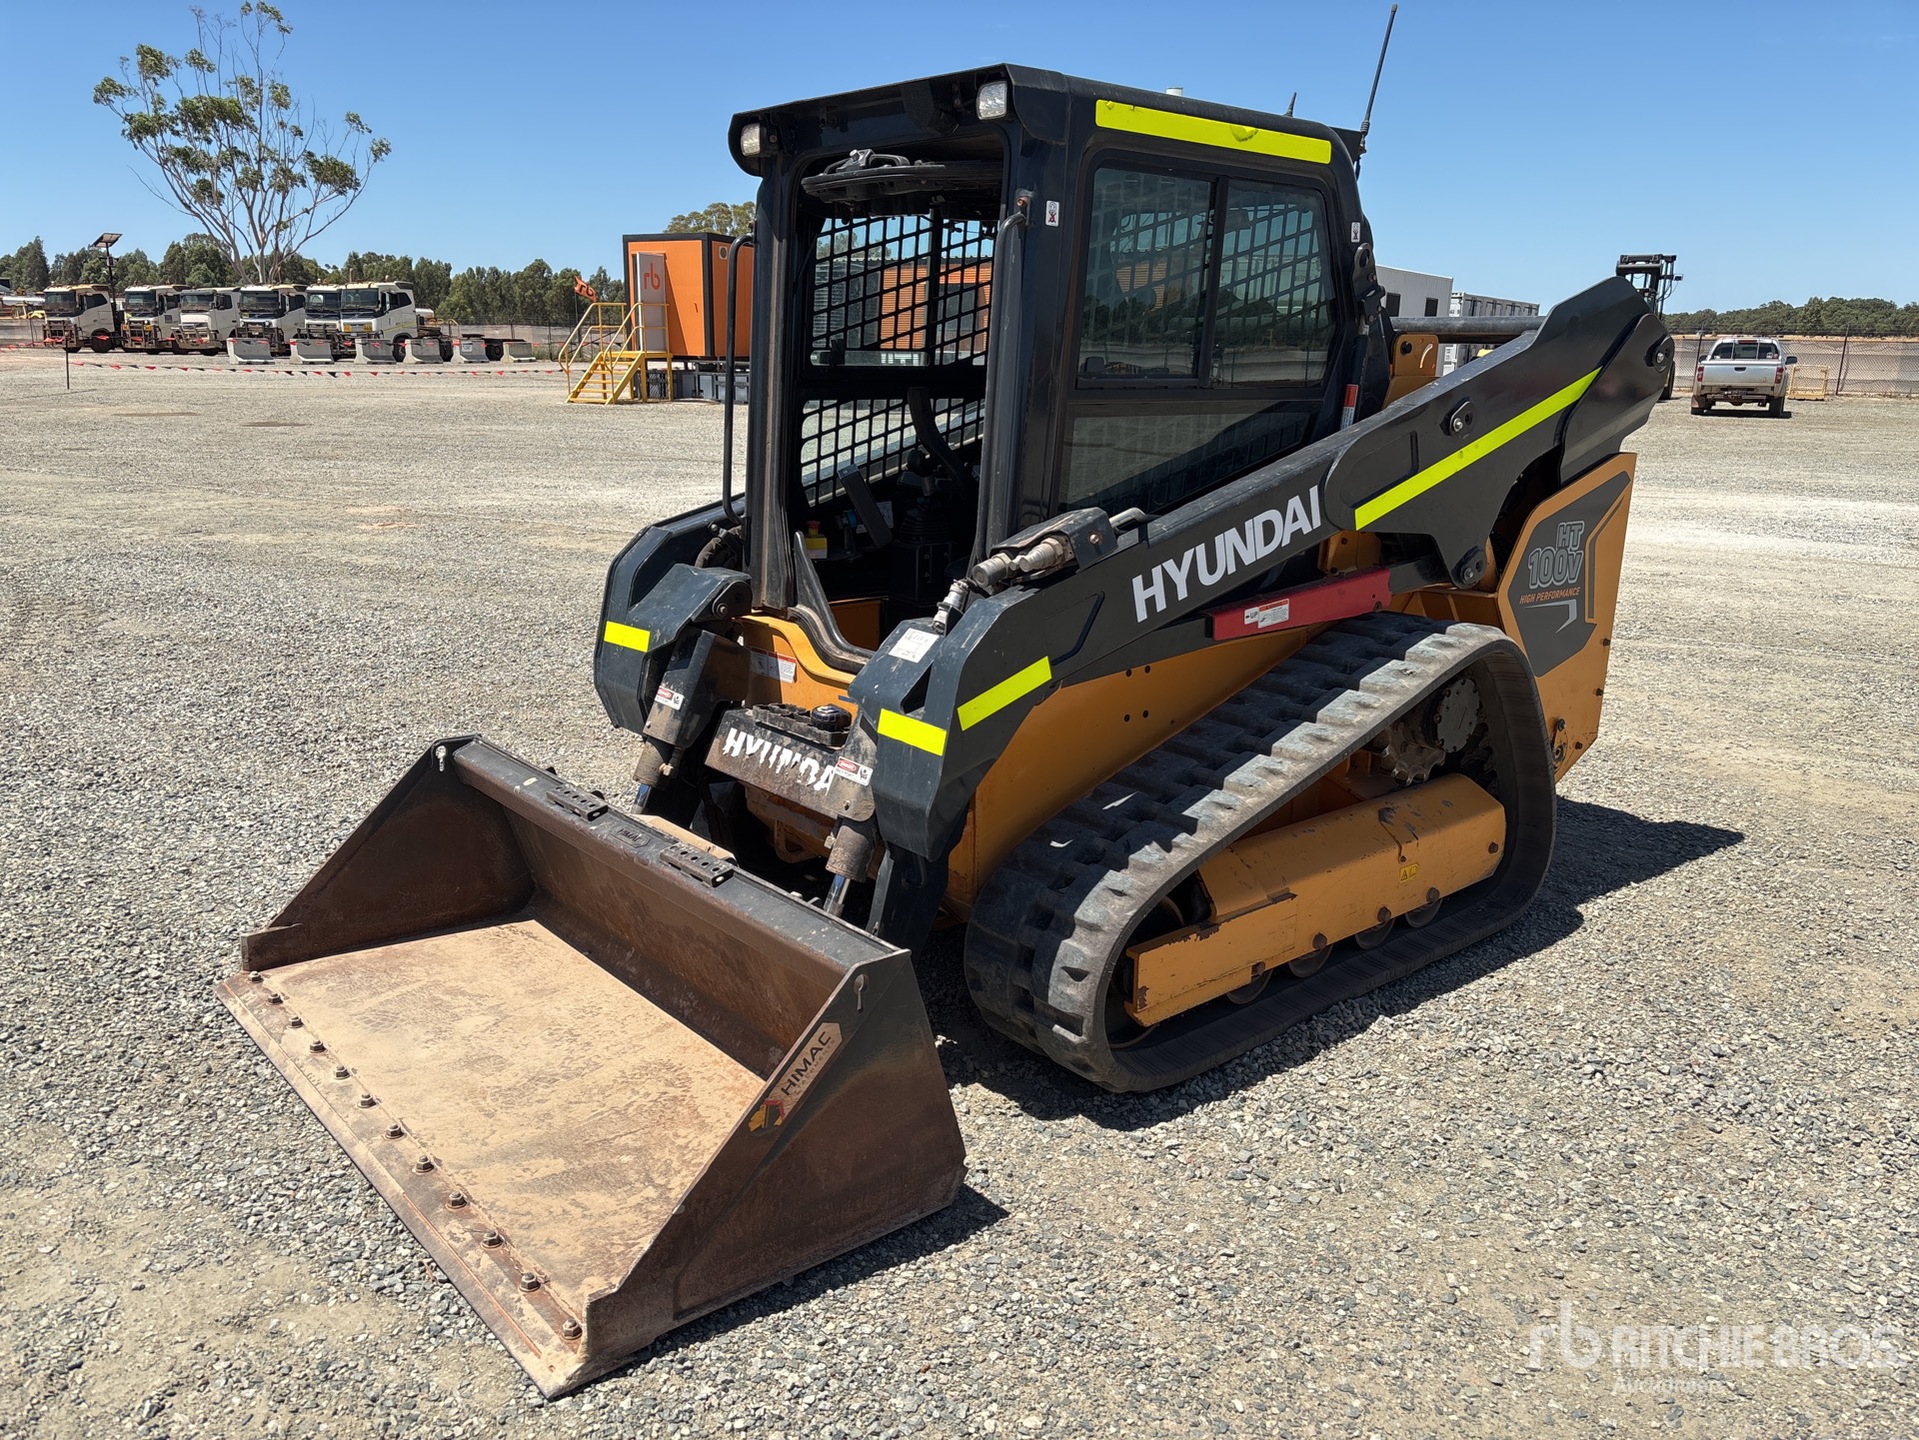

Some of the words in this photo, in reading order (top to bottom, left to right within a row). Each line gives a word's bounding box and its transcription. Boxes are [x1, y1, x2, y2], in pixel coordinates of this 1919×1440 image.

[643, 262, 661, 290] rb
[1557, 521, 1584, 550] HT
[1131, 485, 1322, 624] HYUNDAI
[1520, 594, 1536, 604] HIGH
[1537, 587, 1580, 600] PERFORMANCE
[780, 1031, 832, 1096] HIMAC
